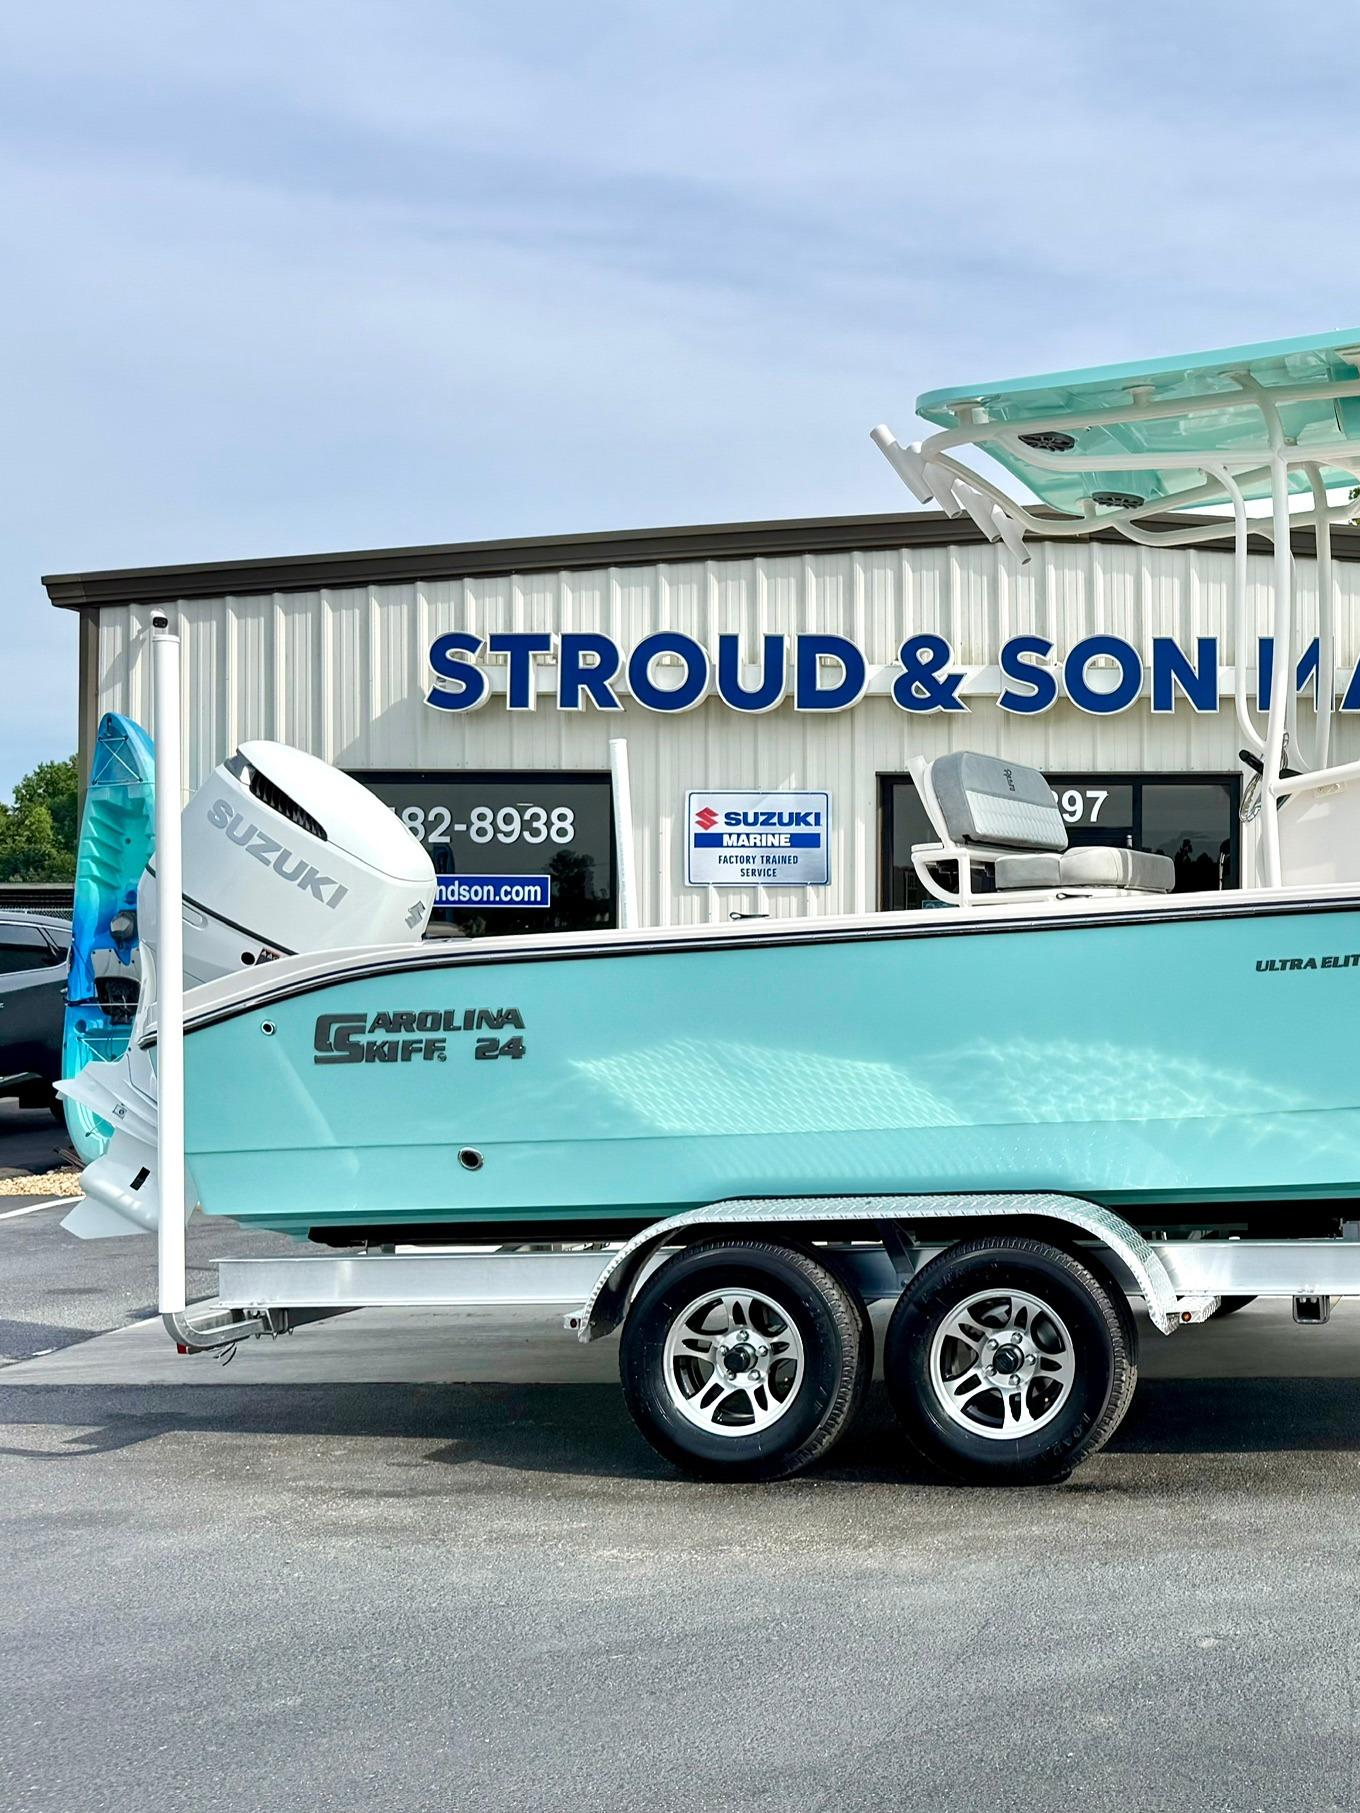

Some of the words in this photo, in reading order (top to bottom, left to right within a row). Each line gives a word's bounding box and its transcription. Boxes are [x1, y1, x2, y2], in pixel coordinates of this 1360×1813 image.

[424, 630, 869, 713] STROUD
[891, 632, 972, 714] &
[995, 633, 1219, 715] SON
[1051, 789, 1108, 823] 97
[390, 806, 575, 844] 82-8938
[724, 811, 822, 827] SUZUKI
[722, 833, 791, 847] MARINE
[207, 799, 349, 909] SUZUKI
[718, 855, 757, 865] FACTORY
[760, 855, 799, 865] TRAINED
[740, 868, 777, 877] SERVICE
[1255, 957, 1318, 972] ULTRA
[314, 1007, 526, 1053] CAROLINA
[474, 1035, 526, 1060] 24
